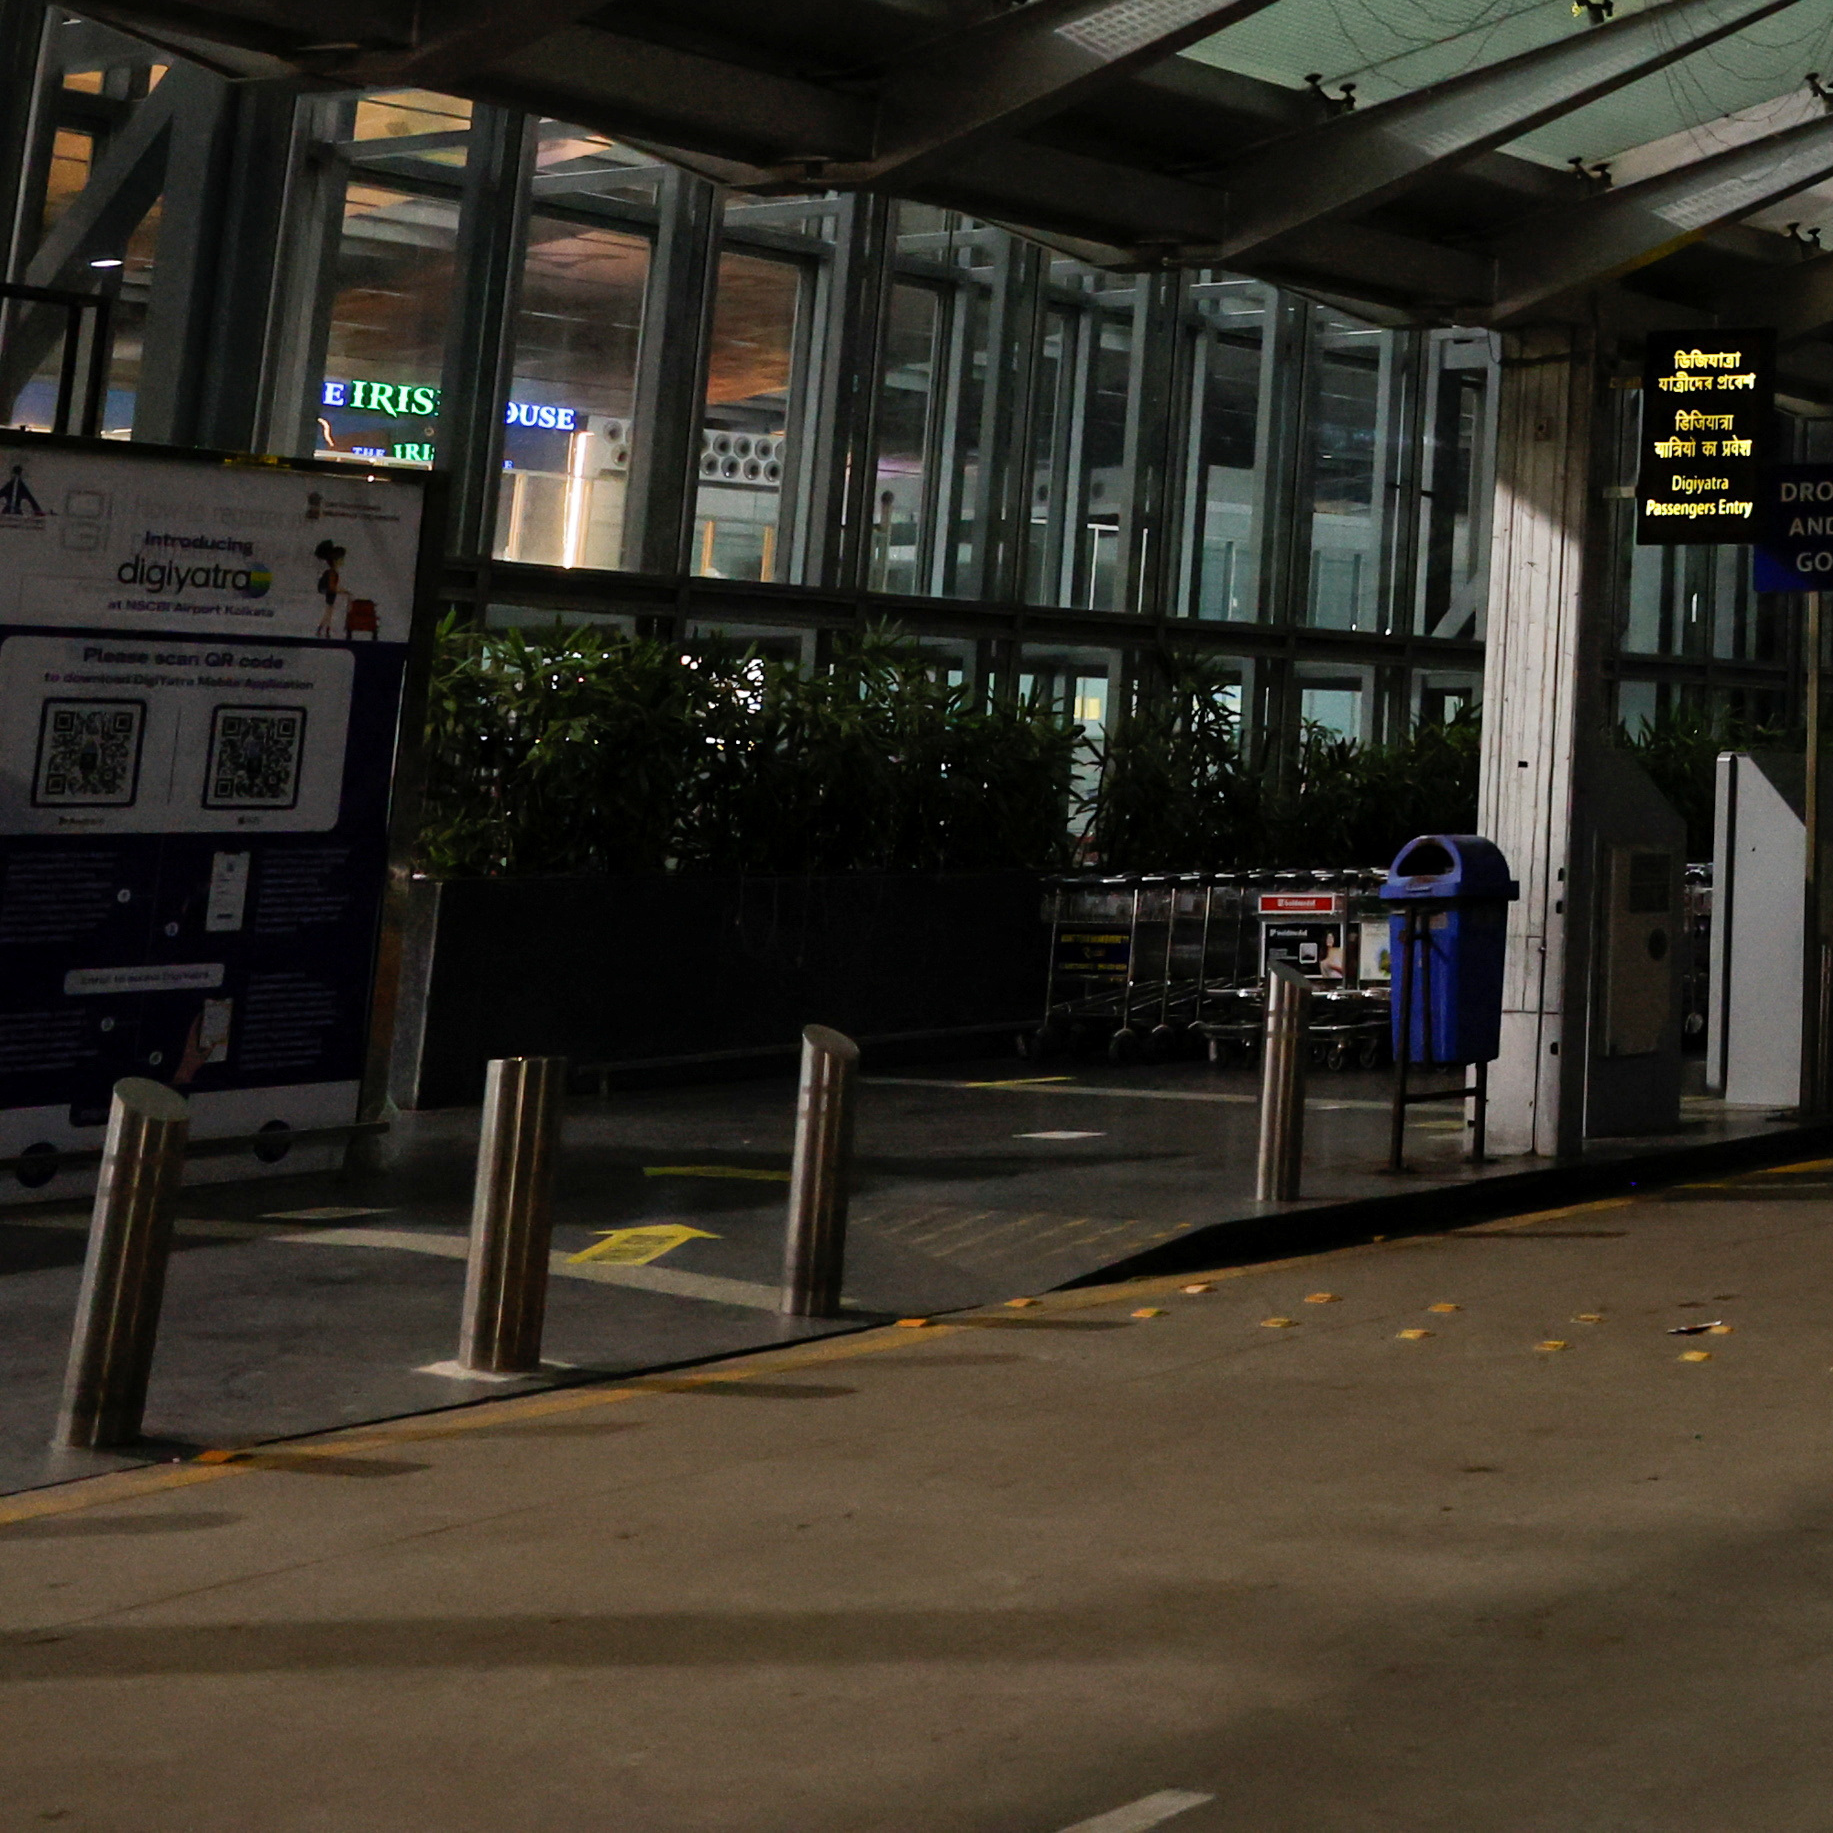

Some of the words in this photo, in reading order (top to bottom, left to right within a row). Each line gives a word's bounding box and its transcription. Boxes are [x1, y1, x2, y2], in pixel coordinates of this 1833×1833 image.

[1702, 440, 1717, 457] का
[1721, 434, 1752, 457] प्रवेश
[1672, 474, 1729, 495] Digiyatra
[1645, 499, 1715, 519] Passengers
[1718, 498, 1753, 519] Entry
[145, 530, 253, 557] Introducing
[1796, 551, 1833, 573] GO
[117, 554, 251, 594] digiyatra
[108, 600, 122, 610] at
[126, 599, 171, 613] NSCBI
[173, 601, 221, 616] Airport
[225, 604, 275, 618] Kolkata
[83, 647, 149, 664] Please
[155, 652, 199, 666] scan
[204, 651, 233, 667] QR
[238, 654, 284, 670] code
[44, 672, 60, 682] to
[63, 672, 131, 685] download
[197, 675, 240, 687] Mobile
[244, 677, 314, 691] Application
